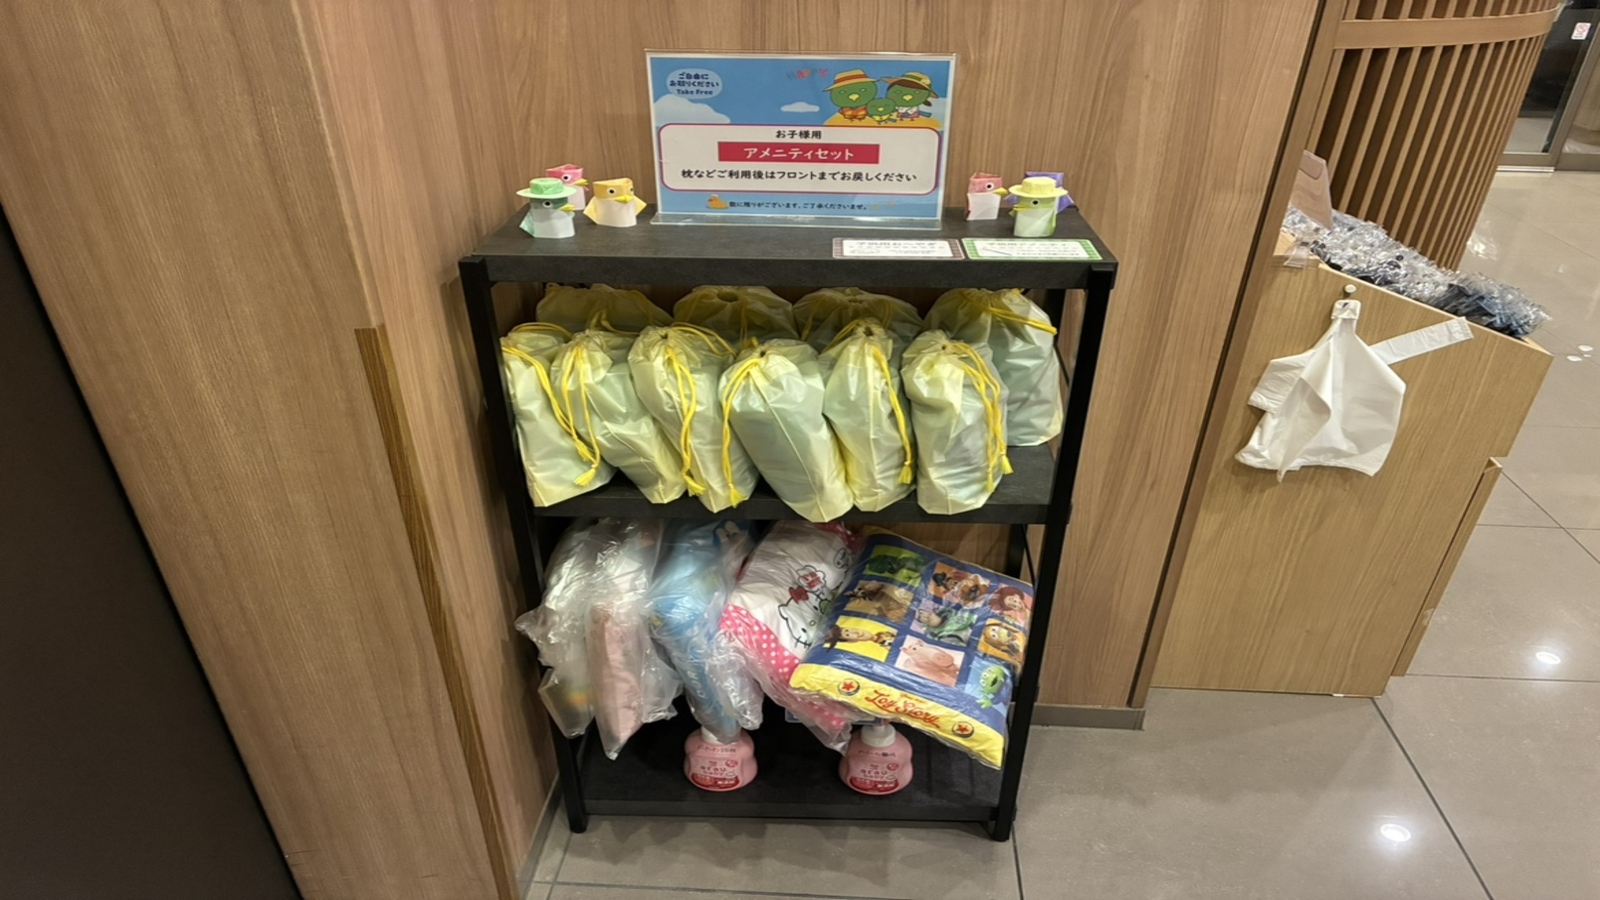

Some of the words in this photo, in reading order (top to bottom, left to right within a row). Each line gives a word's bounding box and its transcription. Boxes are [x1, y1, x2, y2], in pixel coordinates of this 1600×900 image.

[775, 129, 822, 139] お子様用
[743, 147, 854, 161] アメニティセット
[681, 169, 917, 182] 枕などご利用後はフロントまでお戻しください
[865, 690, 897, 709] Toy
[895, 701, 940, 728] Story
